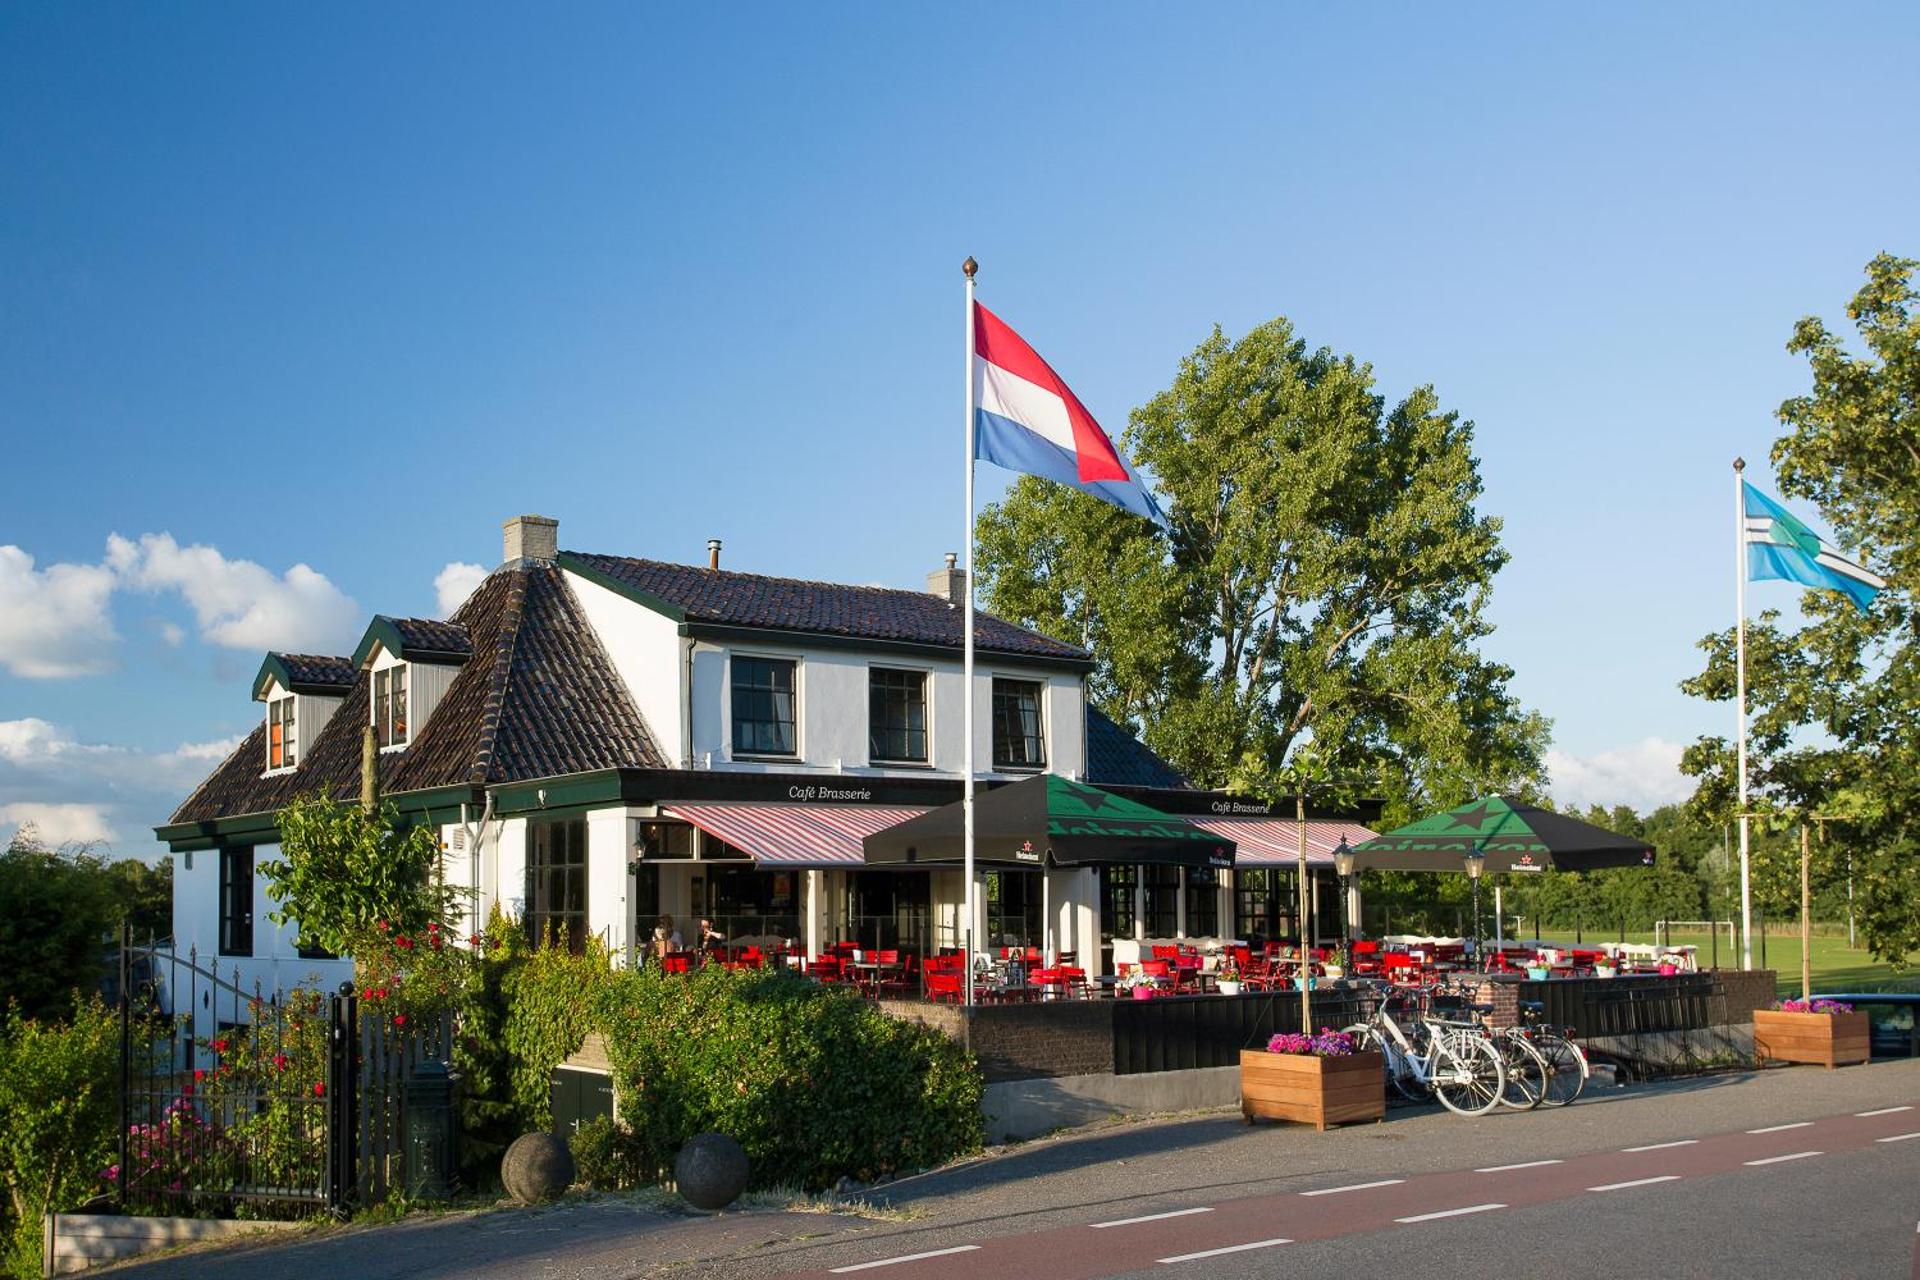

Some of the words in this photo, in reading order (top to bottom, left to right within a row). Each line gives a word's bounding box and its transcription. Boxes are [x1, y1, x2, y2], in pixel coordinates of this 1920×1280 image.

[789, 785, 815, 801] Café
[818, 786, 871, 800] Brasserie
[1211, 801, 1230, 814] Café
